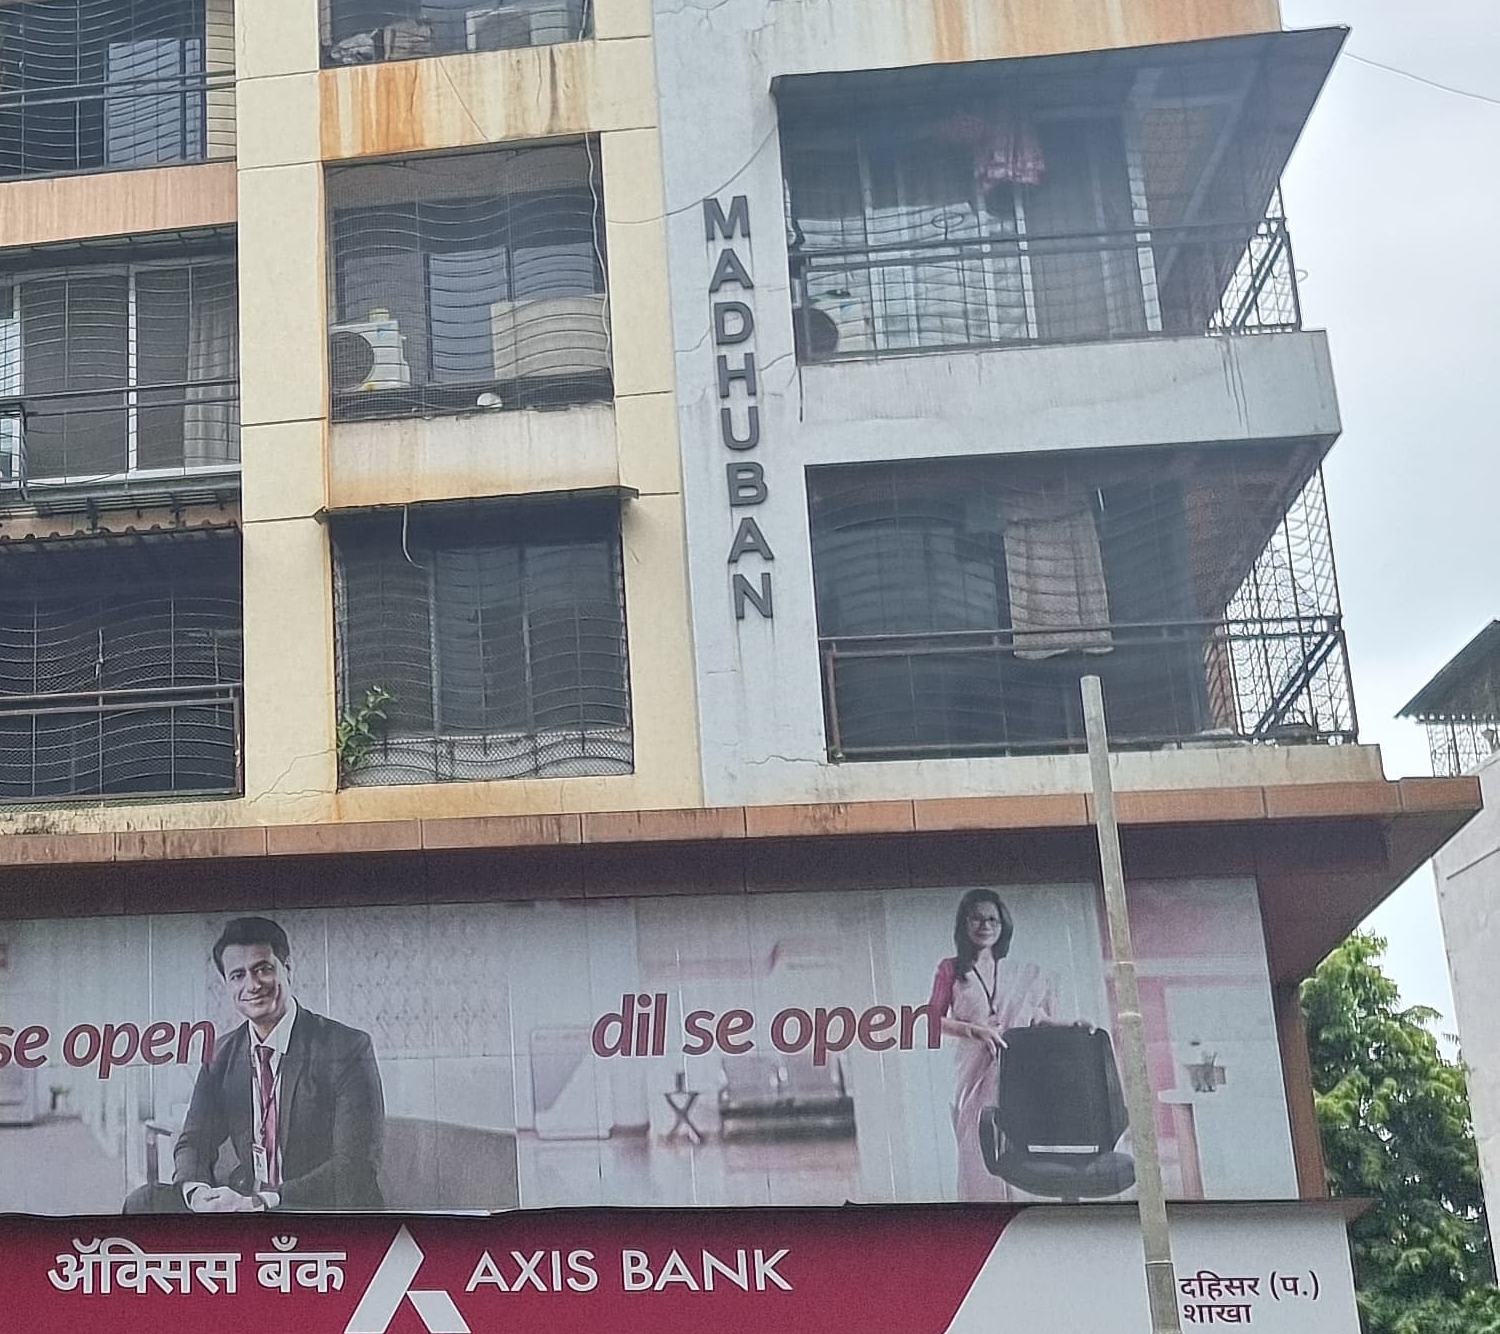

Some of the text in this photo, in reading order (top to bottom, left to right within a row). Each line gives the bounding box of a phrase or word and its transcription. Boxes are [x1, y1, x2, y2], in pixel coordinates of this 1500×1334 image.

[703, 195, 775, 620] MADHUBAN
[63, 1018, 216, 1079] open
[592, 992, 943, 1066] dil se open
[465, 1247, 792, 1293] AXIS BANK
[1179, 1269, 1320, 1300] दहिसर (प.)
[1183, 1304, 1251, 1323] शाखा
